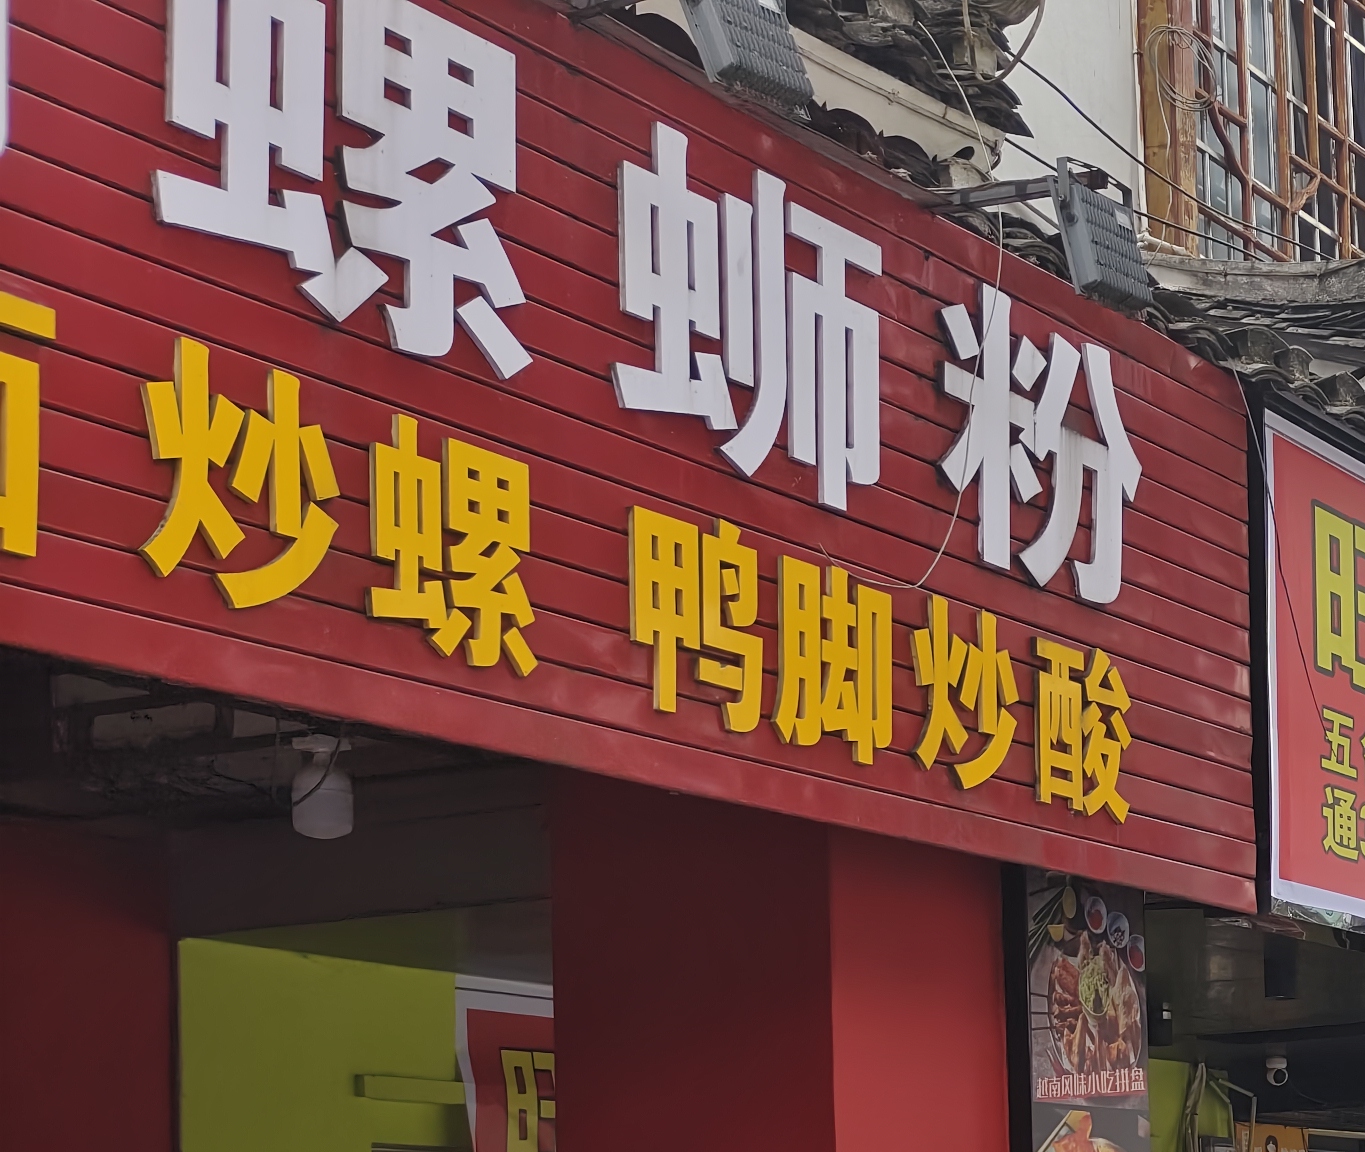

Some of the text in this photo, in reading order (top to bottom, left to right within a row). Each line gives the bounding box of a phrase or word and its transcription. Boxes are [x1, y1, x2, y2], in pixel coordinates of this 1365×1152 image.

[152, 0, 1143, 605] 螺蛳粉
[139, 336, 541, 678] 炒螺
[628, 505, 1132, 823] 鸭脚炒酸
[1036, 1067, 1146, 1099] 越南风味小吃拼盘
